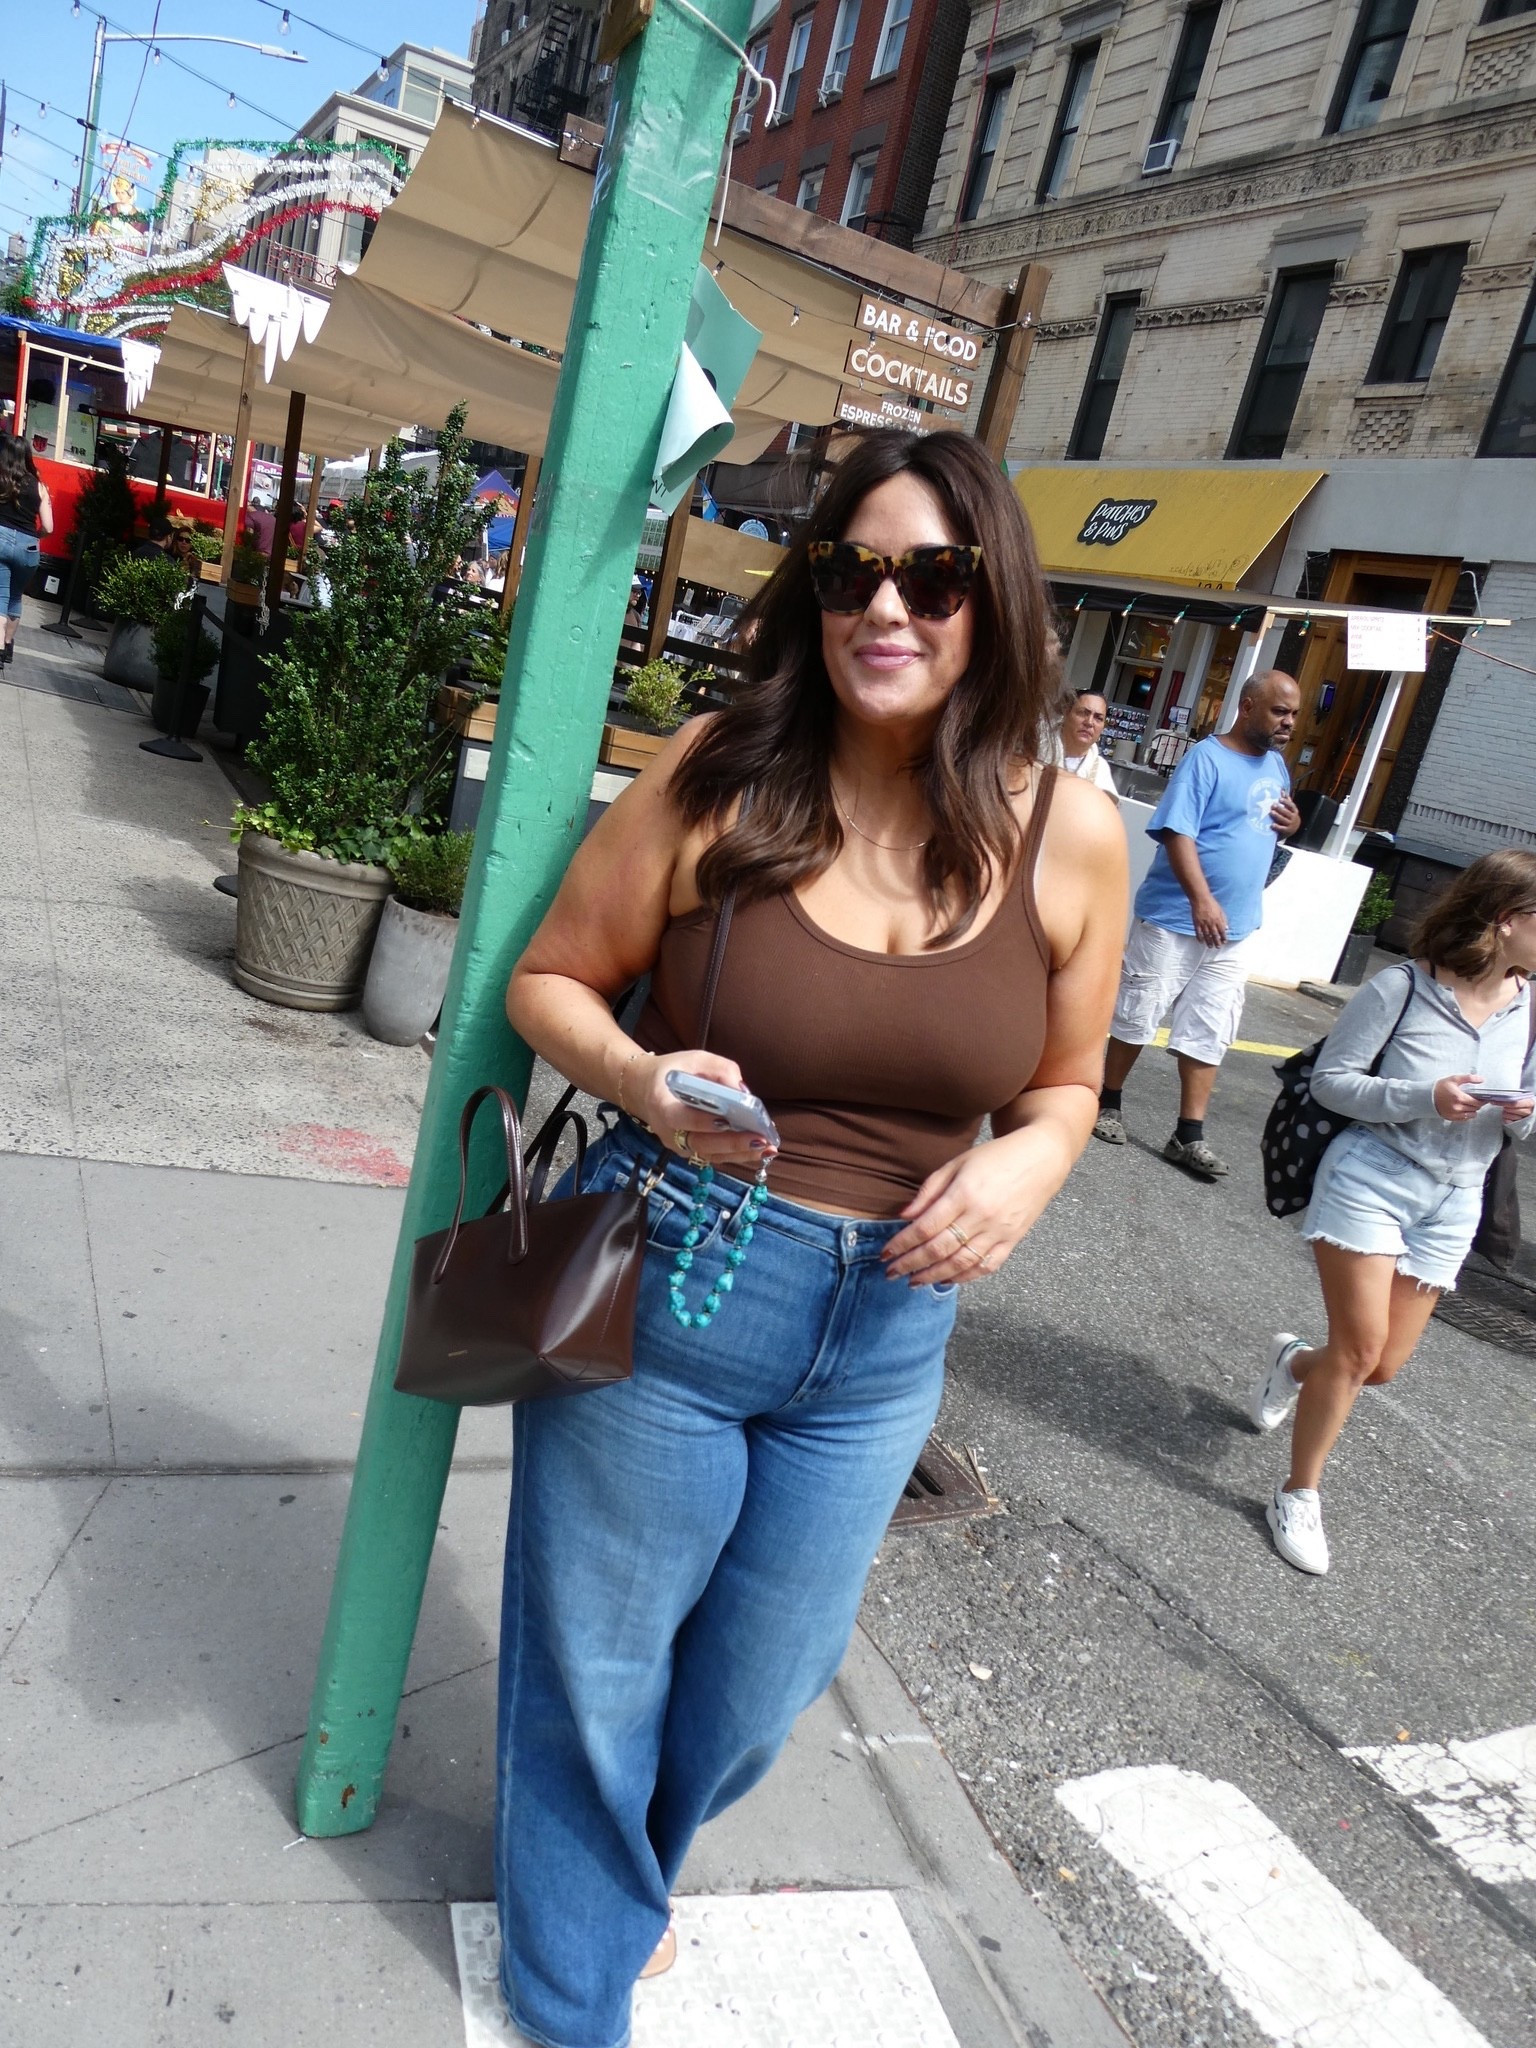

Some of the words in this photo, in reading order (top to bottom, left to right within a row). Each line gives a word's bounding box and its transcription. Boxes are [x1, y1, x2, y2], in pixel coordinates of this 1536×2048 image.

[863, 304, 901, 335] BAR
[905, 320, 919, 342] &
[924, 326, 977, 361] FOOD
[851, 348, 968, 405] COCKTAILS
[881, 401, 922, 424] FROZEN
[1083, 521, 1098, 537] &
